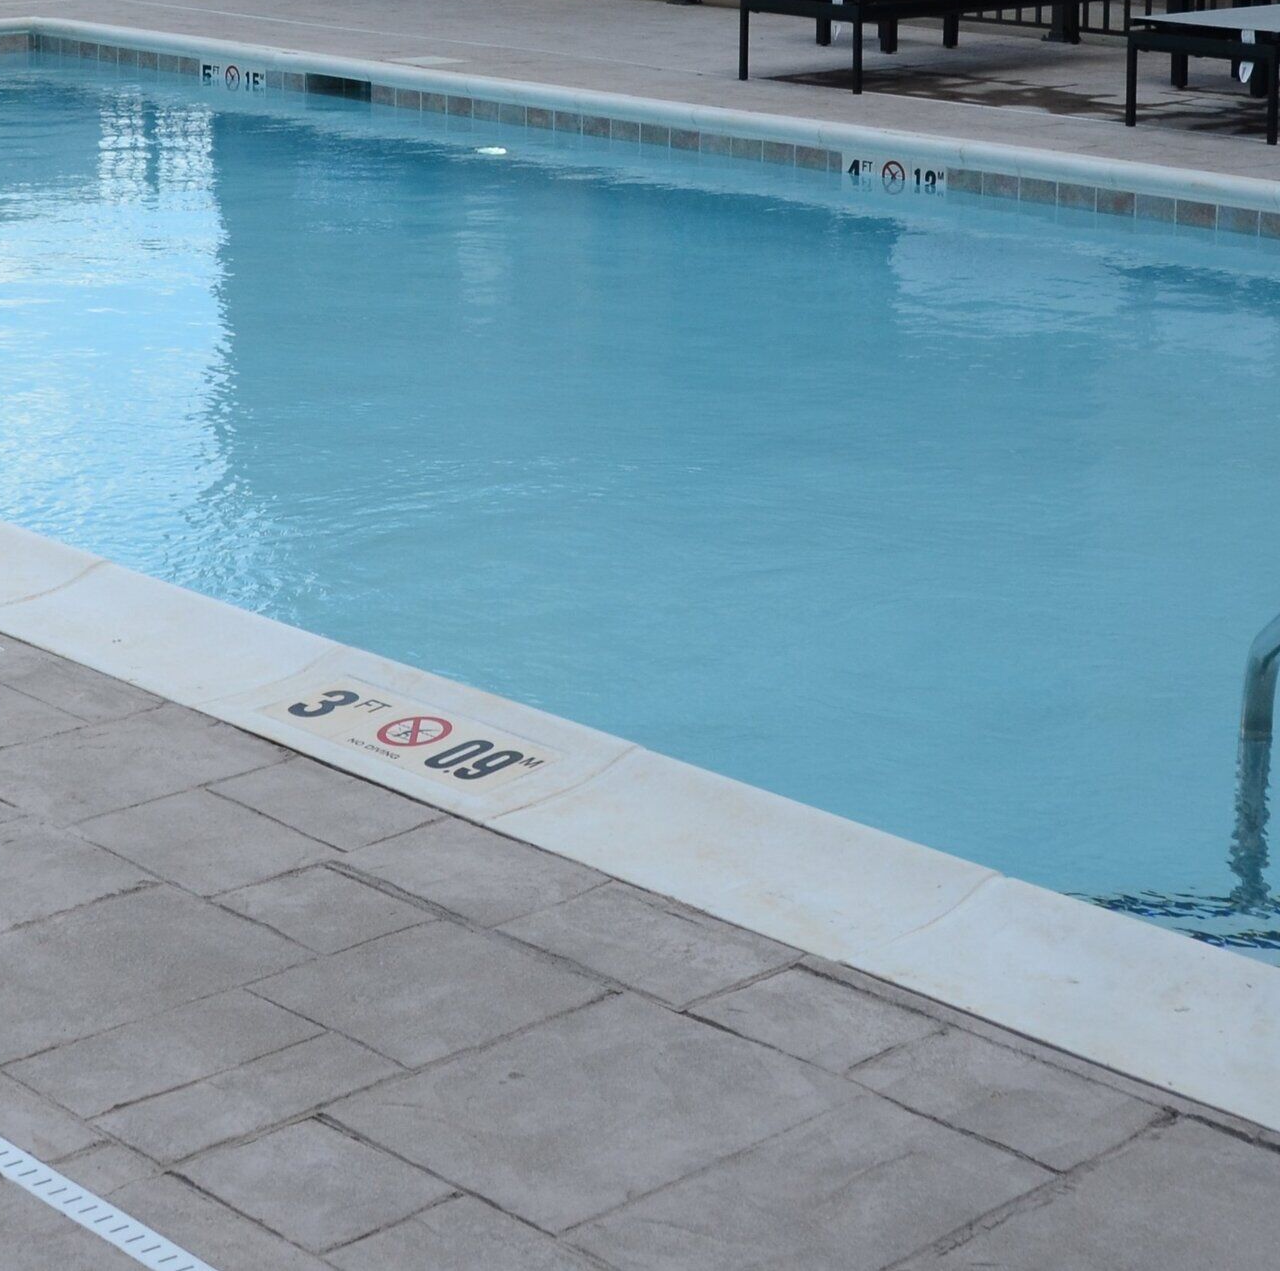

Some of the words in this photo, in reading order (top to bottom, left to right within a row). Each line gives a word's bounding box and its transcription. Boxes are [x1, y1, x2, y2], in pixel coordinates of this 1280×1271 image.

[202, 65, 212, 78] 5
[213, 66, 220, 74] FT
[847, 159, 860, 176] 4
[862, 161, 873, 173] FT
[937, 171, 944, 180] M
[288, 690, 360, 718] 3
[354, 699, 392, 713] FT
[424, 739, 524, 780] 0.9
[520, 756, 544, 769] M
[347, 737, 366, 746] NO
[364, 744, 401, 760] DIVING
